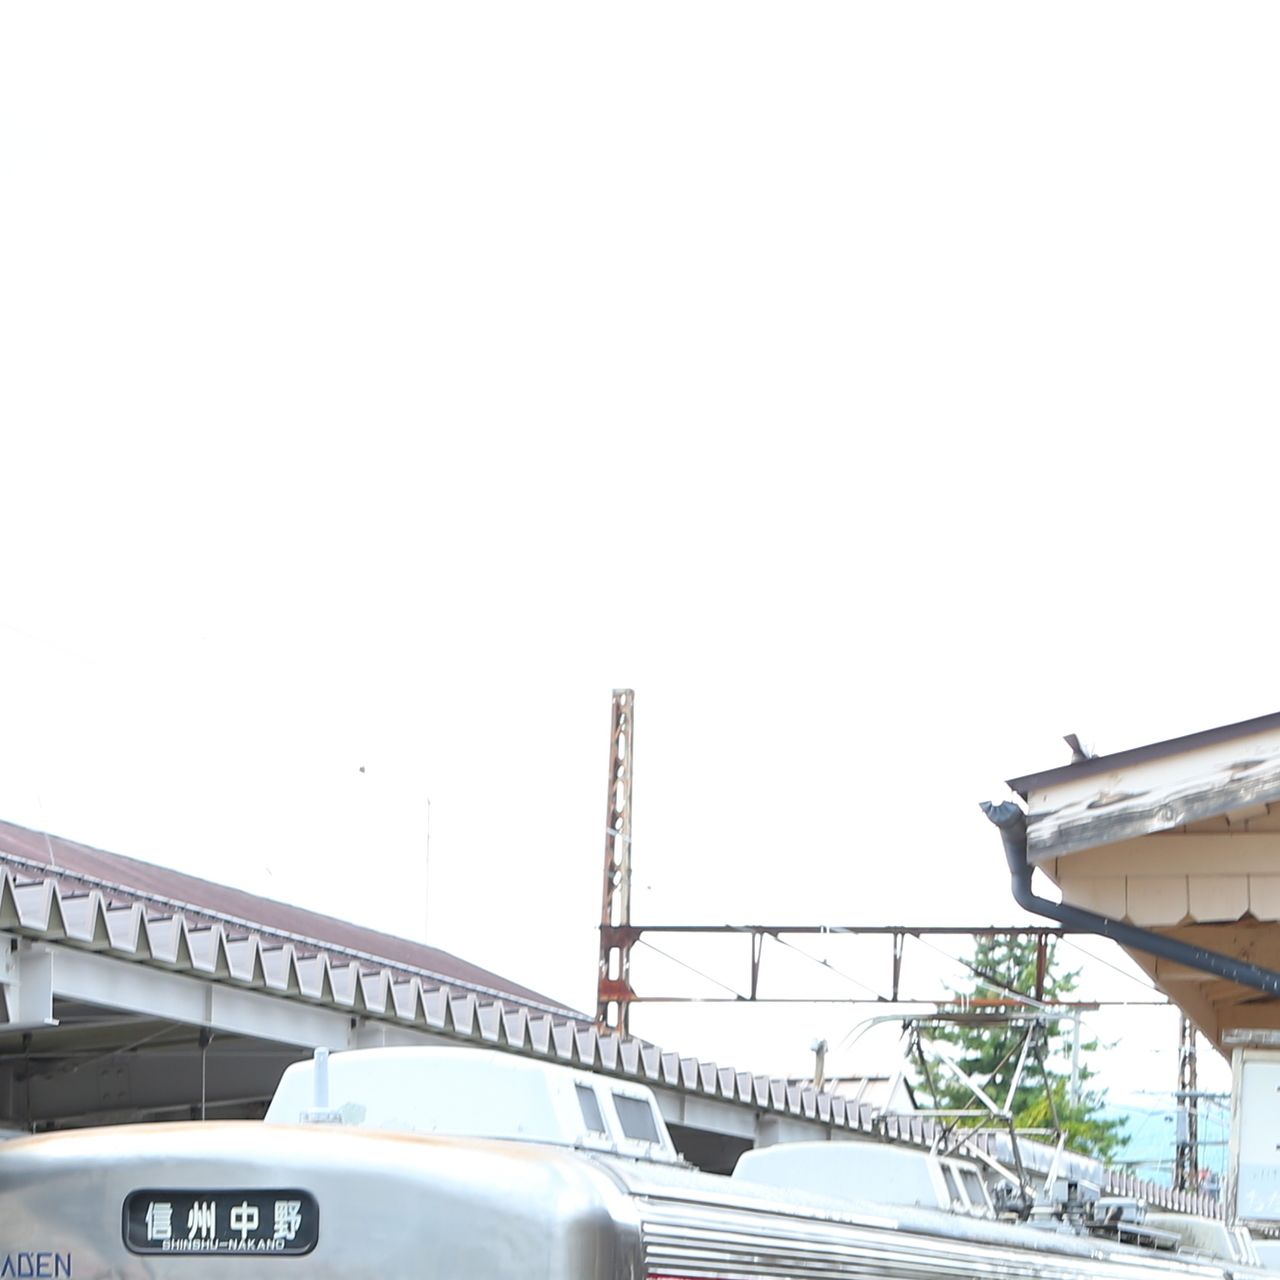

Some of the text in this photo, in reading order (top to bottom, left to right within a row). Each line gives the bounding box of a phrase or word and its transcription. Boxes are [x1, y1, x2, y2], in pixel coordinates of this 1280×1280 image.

[145, 1200, 303, 1241] 信州中野
[161, 1239, 286, 1250] SHINSHU-NAKANO
